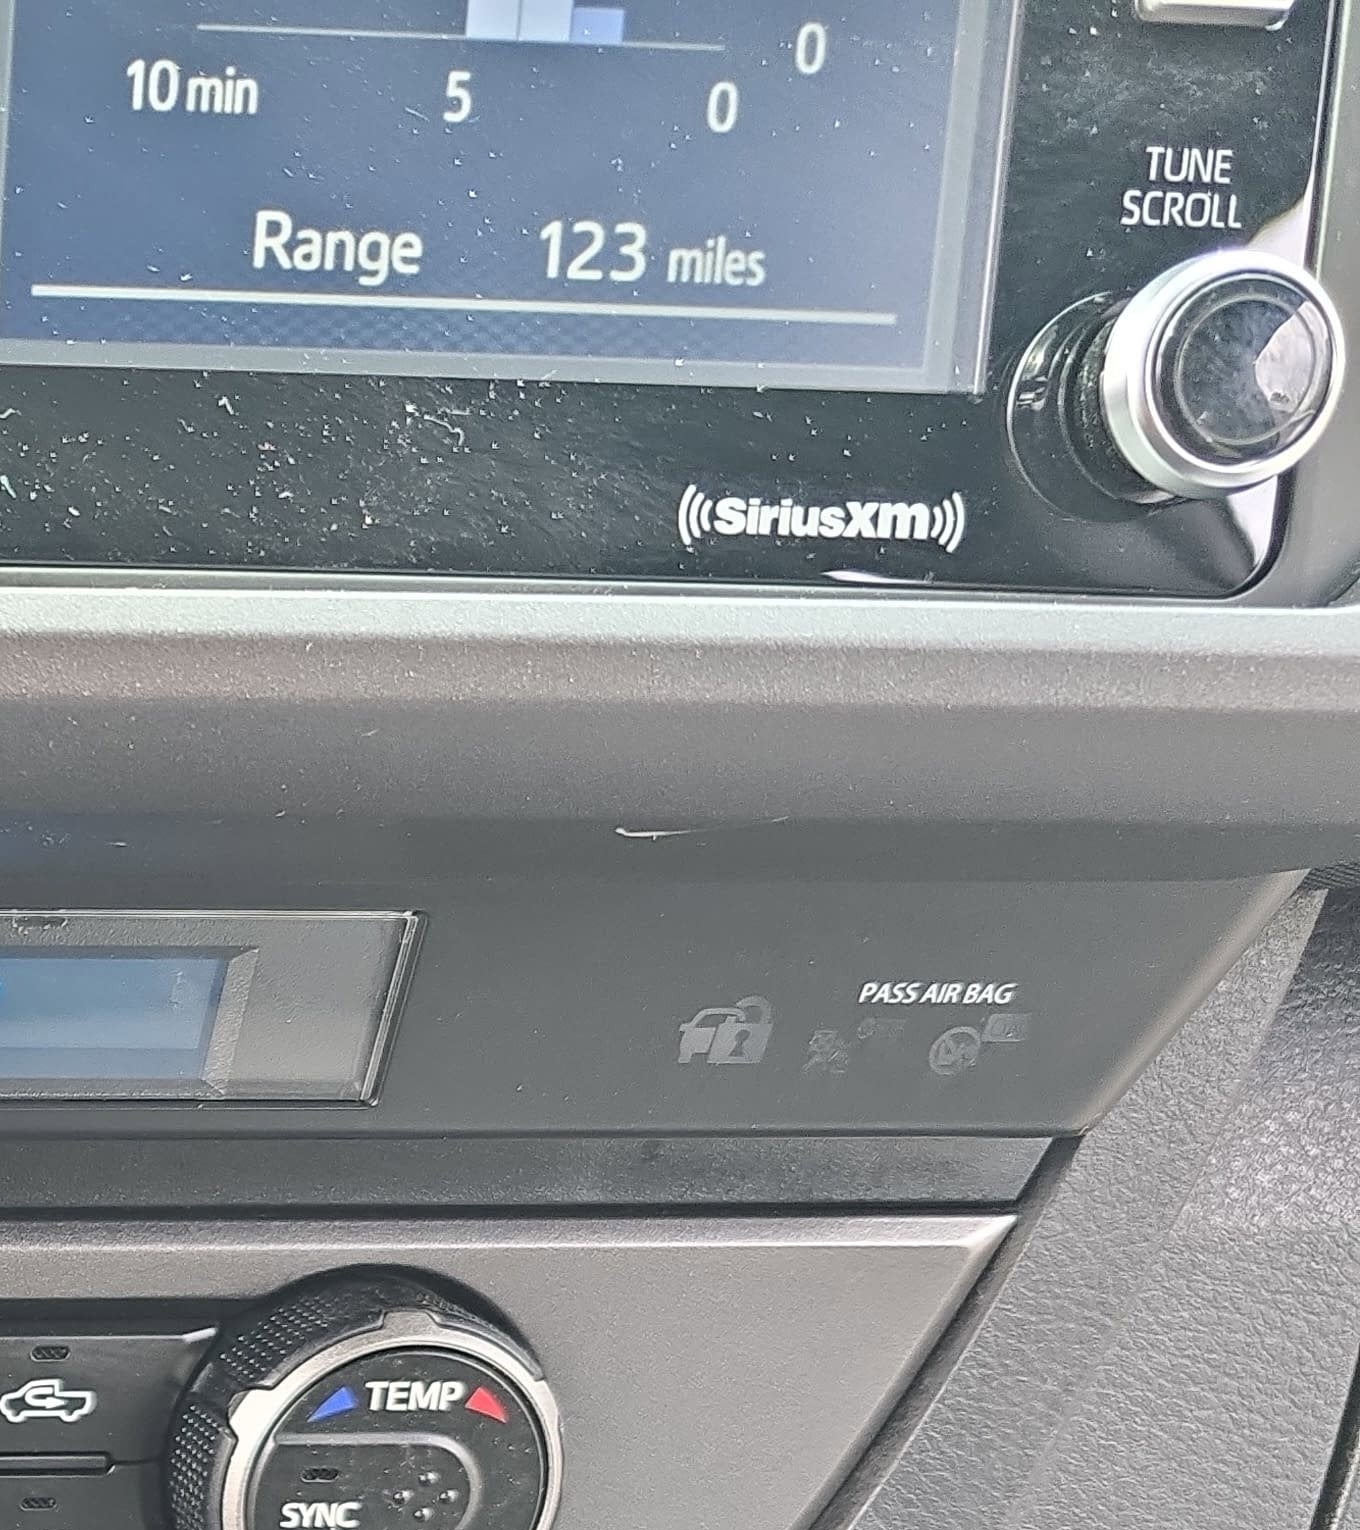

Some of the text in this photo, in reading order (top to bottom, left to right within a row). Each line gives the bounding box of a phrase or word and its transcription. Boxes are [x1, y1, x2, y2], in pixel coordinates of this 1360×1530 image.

[796, 23, 826, 74] 0
[127, 60, 738, 132] 10 min 5 0
[1146, 146, 1232, 183] TUNE
[1121, 190, 1241, 228] SCROLL
[253, 211, 765, 286] Range 123 miles
[858, 982, 1018, 1004] PASS AIR BAG
[365, 1381, 465, 1410] TEMP
[280, 1502, 361, 1528] SYNC
